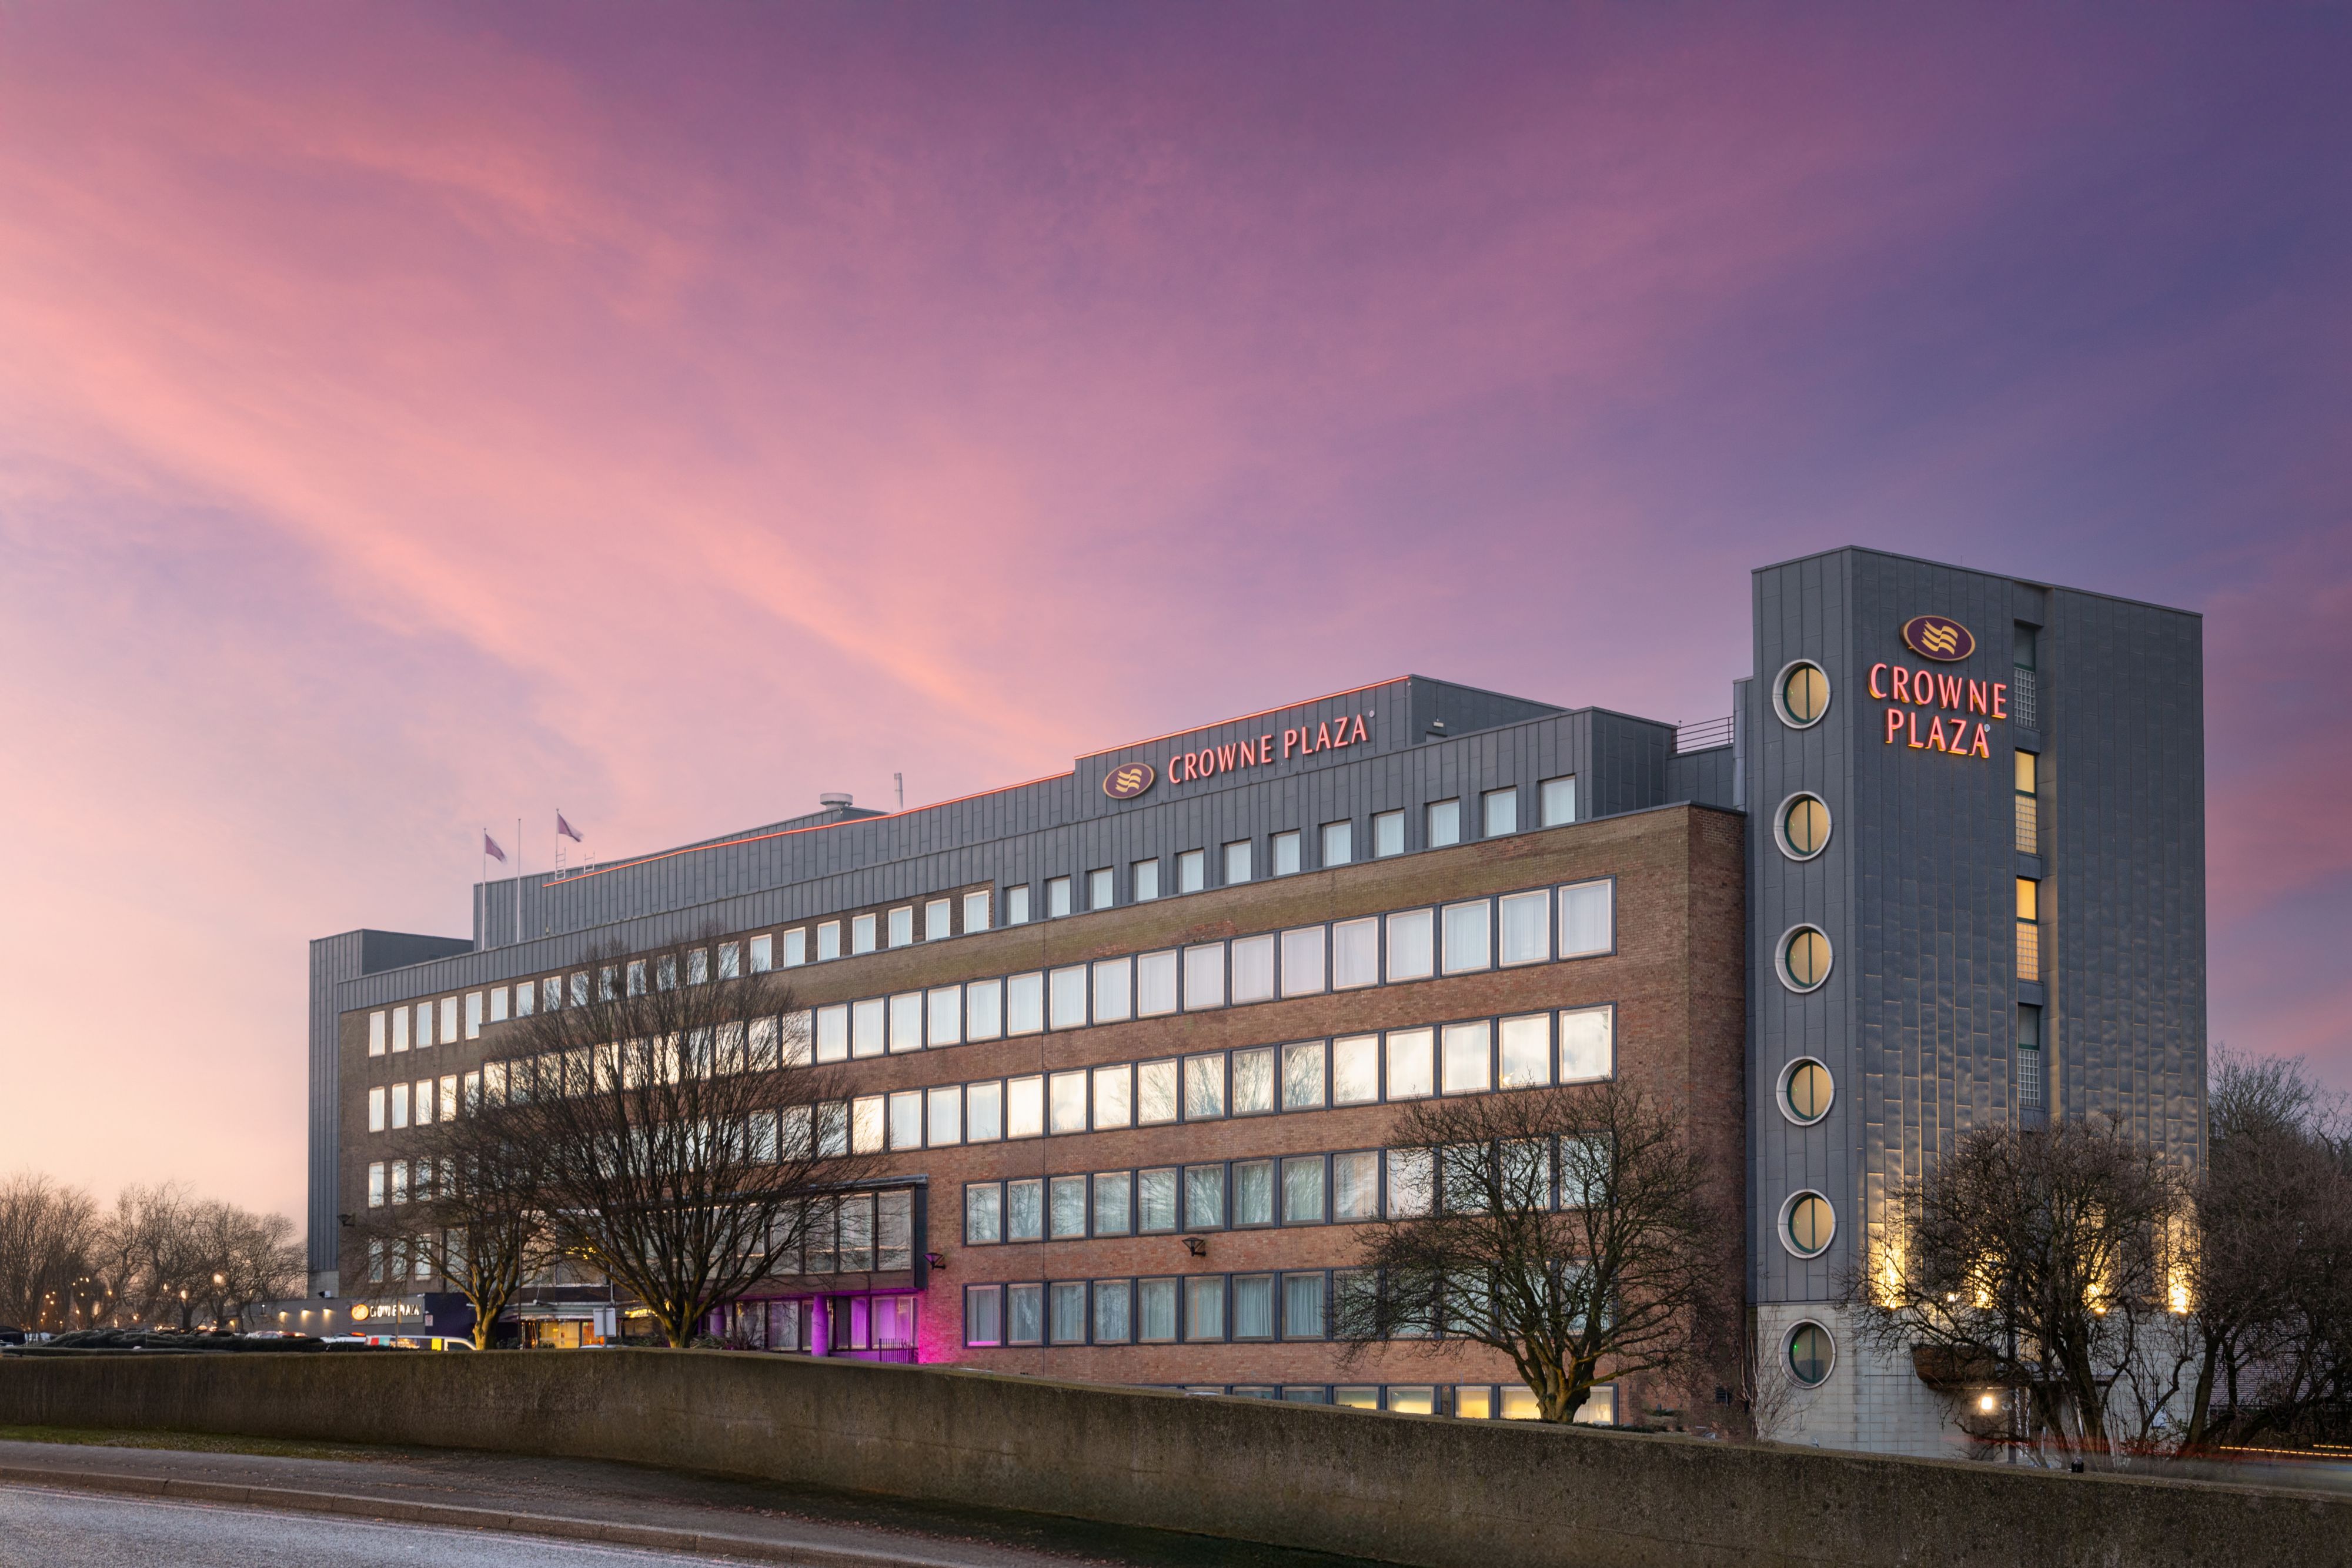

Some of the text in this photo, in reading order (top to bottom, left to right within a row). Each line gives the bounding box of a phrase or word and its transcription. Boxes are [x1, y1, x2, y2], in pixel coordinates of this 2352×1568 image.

[1868, 663, 2007, 718] CROWNE
[1168, 714, 1368, 784] CROWNE PLAZA
[1885, 708, 1990, 758] PLAZA
